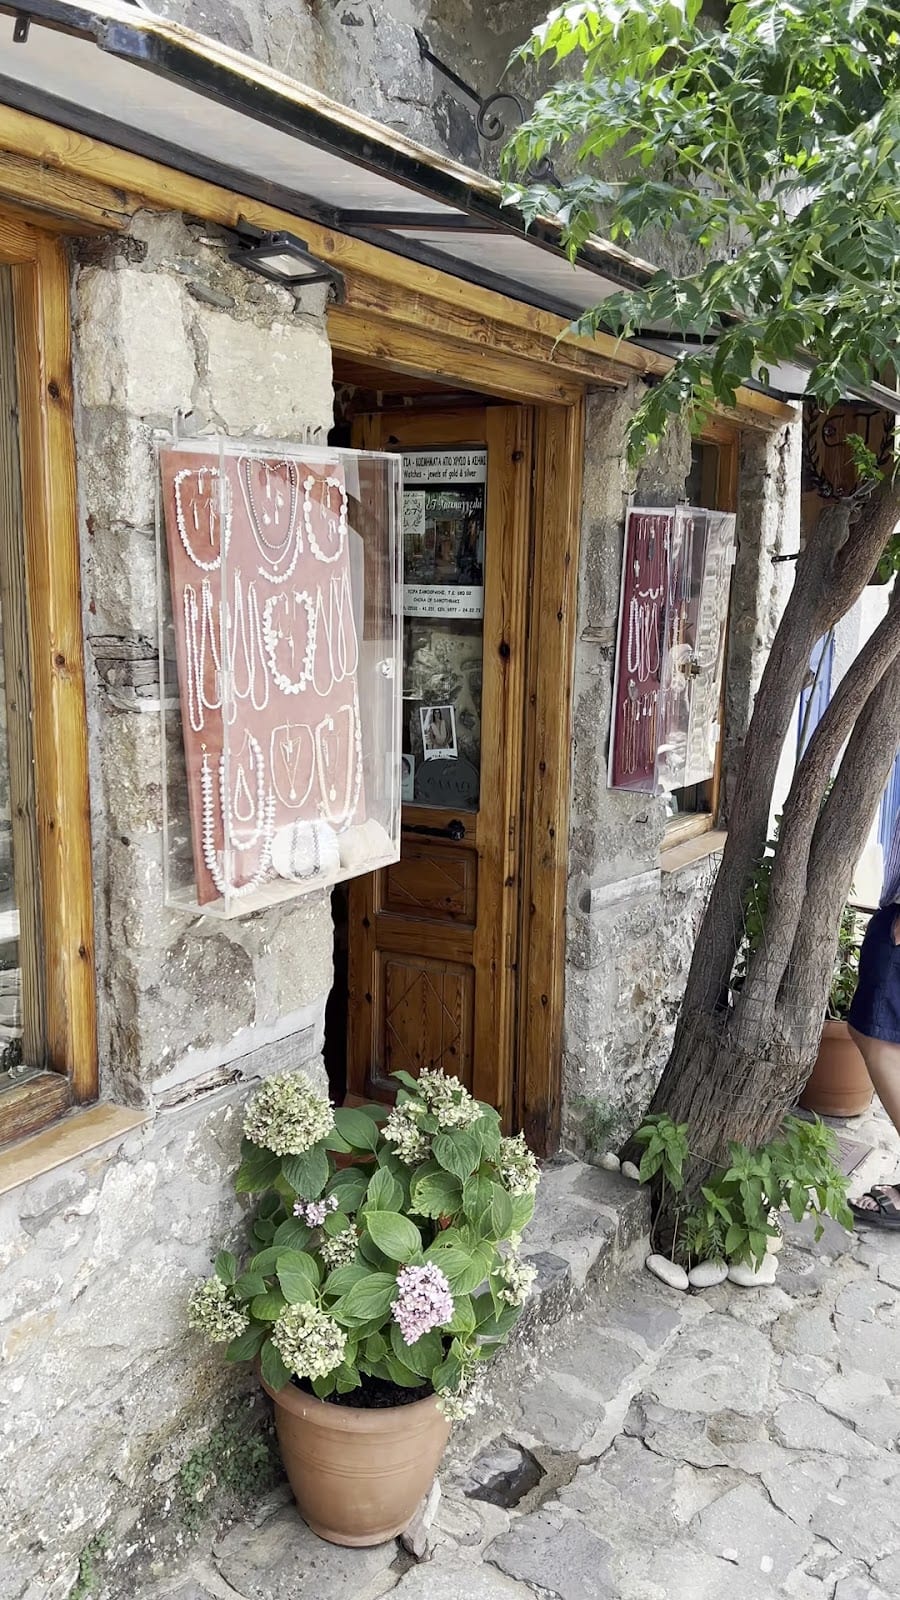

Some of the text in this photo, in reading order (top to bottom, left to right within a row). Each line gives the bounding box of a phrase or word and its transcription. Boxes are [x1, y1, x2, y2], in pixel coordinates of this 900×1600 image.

[427, 469, 441, 480] jewels
[442, 468, 448, 478] of
[448, 468, 458, 480] gold
[464, 468, 476, 478] silver
